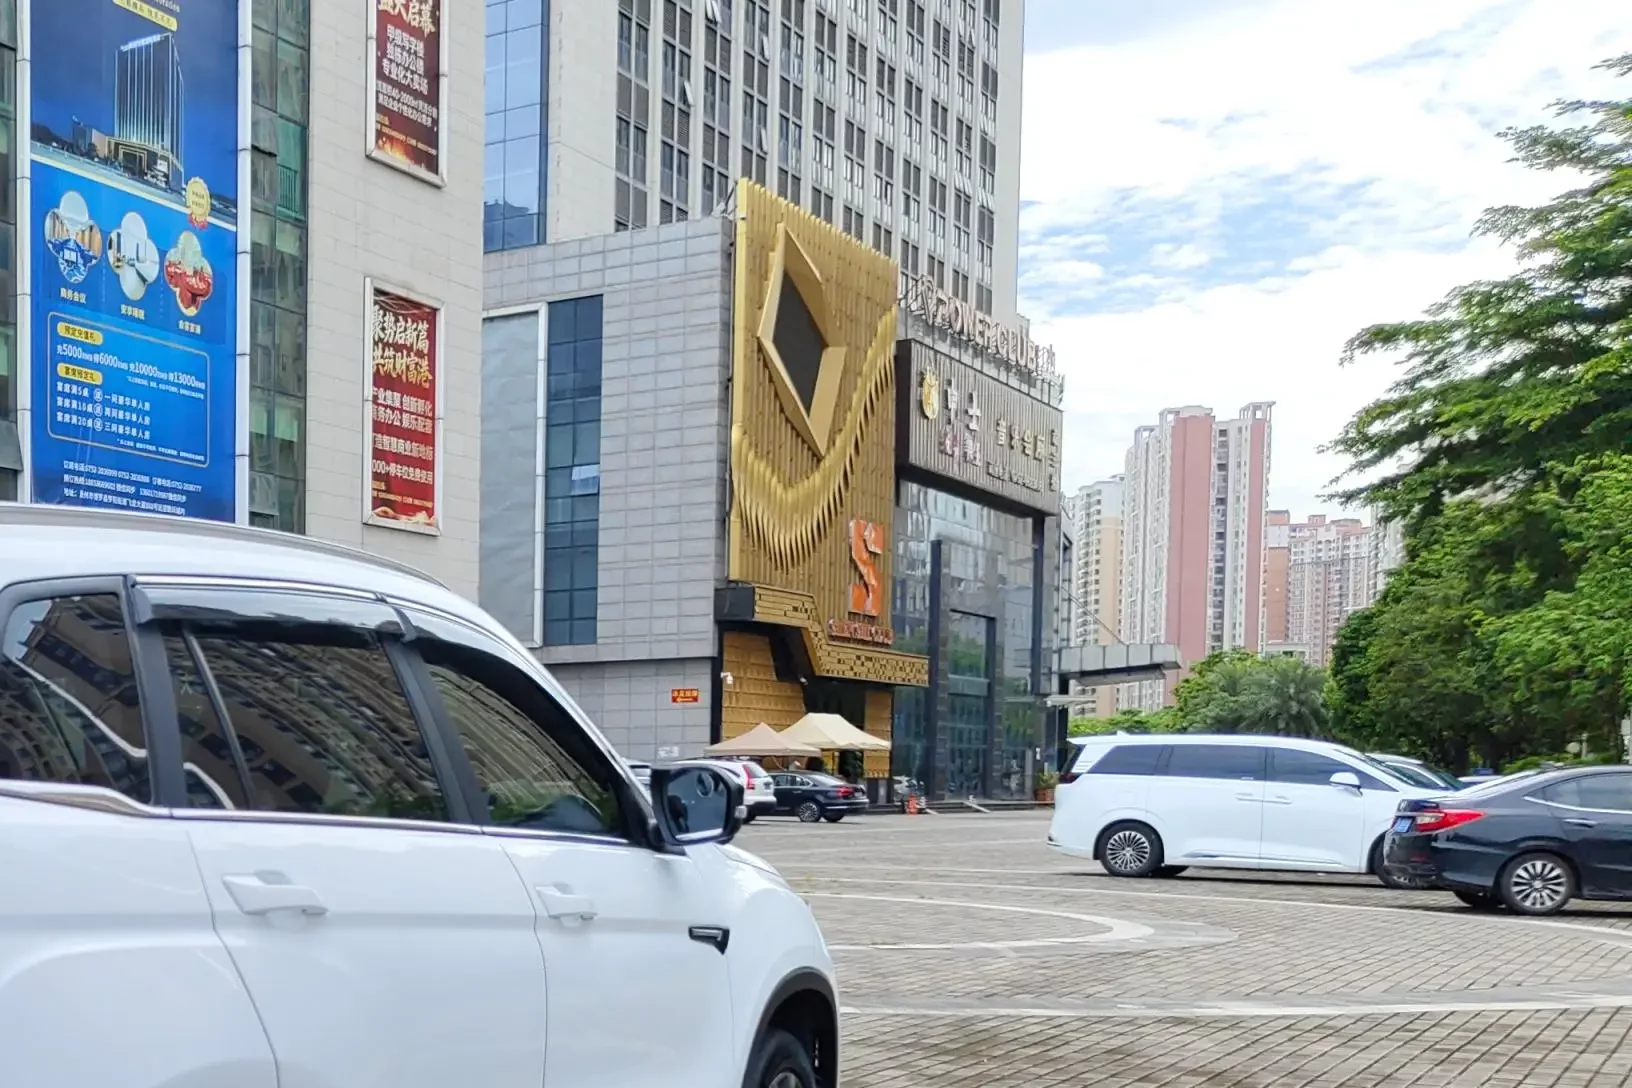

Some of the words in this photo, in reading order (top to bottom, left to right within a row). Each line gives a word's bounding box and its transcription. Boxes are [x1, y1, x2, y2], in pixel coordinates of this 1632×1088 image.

[386, 42, 424, 76] 独栋办公楼
[387, 23, 424, 58] 甲级写字楼
[382, 58, 428, 95] 专业化大卖场
[373, 304, 429, 353] 聚势启新篇
[373, 342, 433, 389] 共筑财富港
